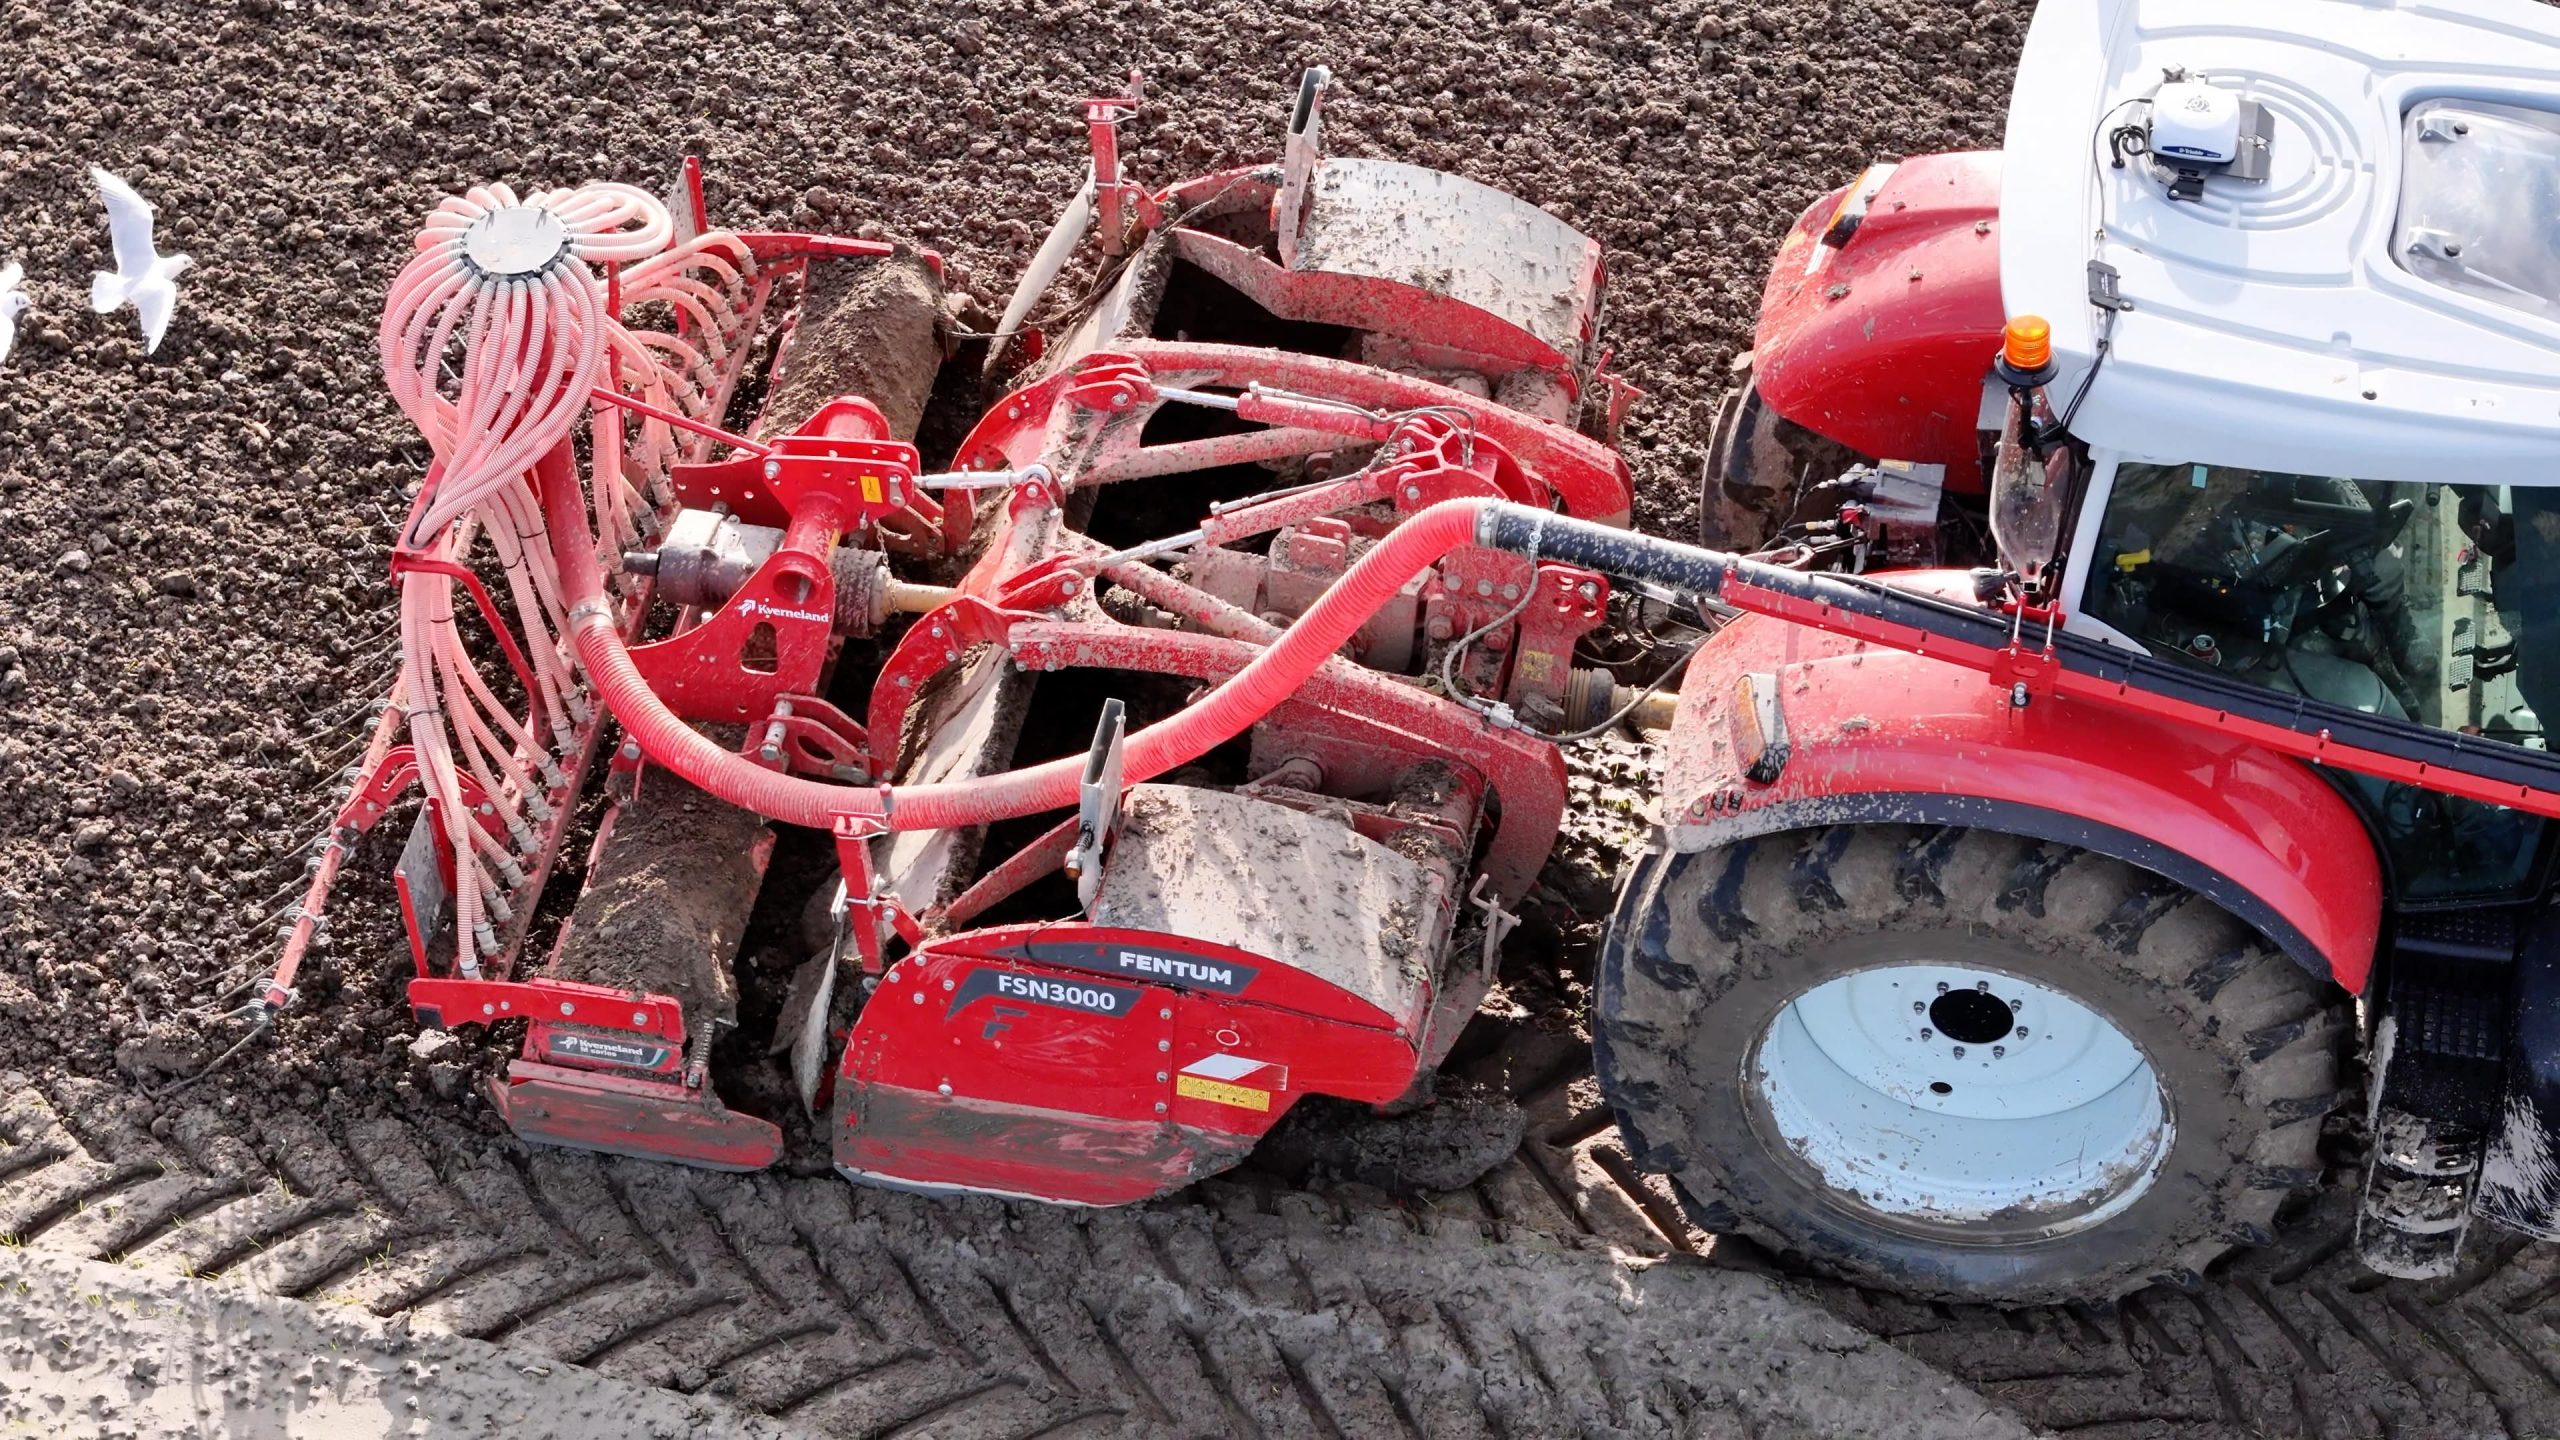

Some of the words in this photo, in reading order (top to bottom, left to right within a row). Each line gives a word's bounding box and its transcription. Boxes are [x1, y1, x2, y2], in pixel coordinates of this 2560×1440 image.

[758, 604, 829, 623] Kverneland
[1119, 951, 1232, 985] FENTUM
[998, 974, 1116, 1011] FSN3000
[580, 1039, 643, 1056] Kverneland
